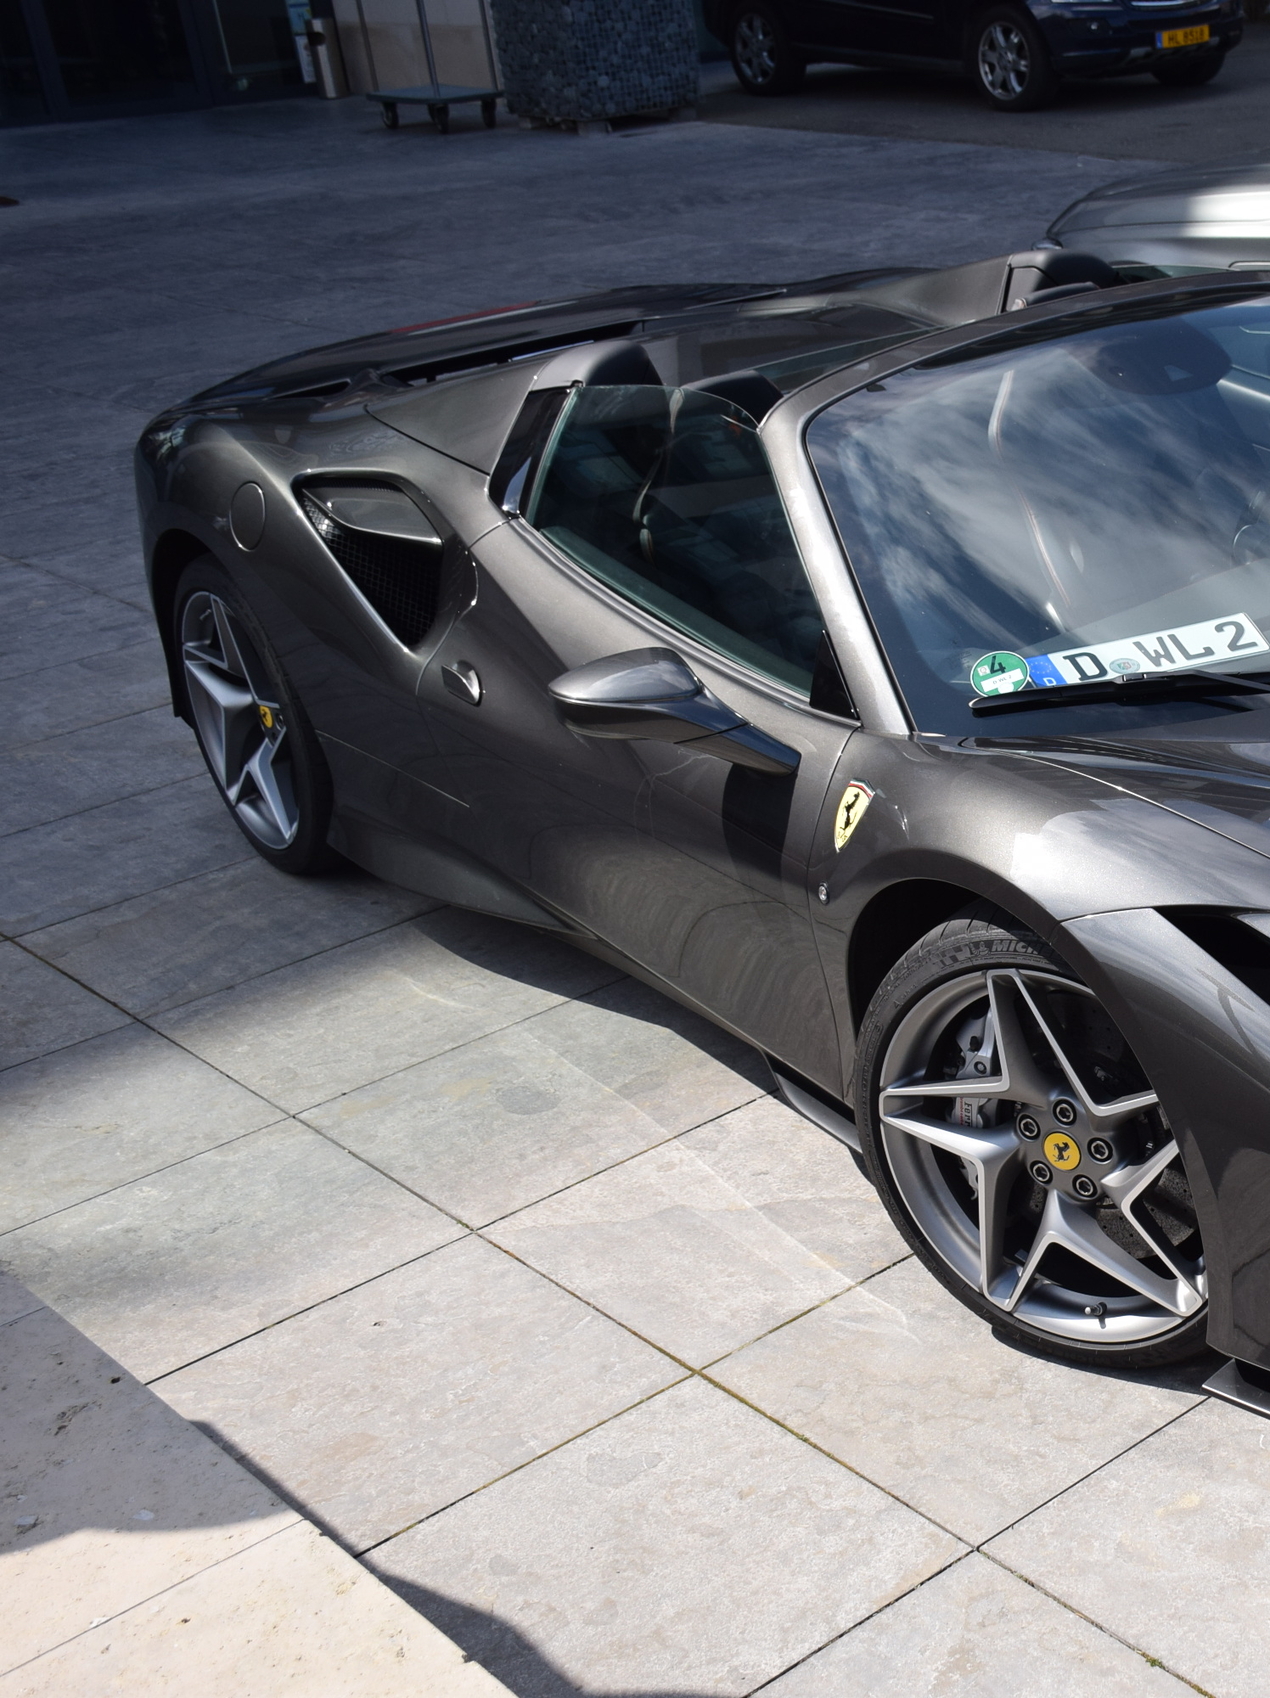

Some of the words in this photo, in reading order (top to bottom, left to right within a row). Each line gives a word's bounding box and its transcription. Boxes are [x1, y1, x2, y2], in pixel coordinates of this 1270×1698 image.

[1168, 32, 1180, 45] HL
[1063, 651, 1108, 682] D
[1133, 633, 1215, 667] WL
[1214, 620, 1258, 651] 2
[990, 655, 1006, 674] 4
[1043, 677, 1057, 686] D
